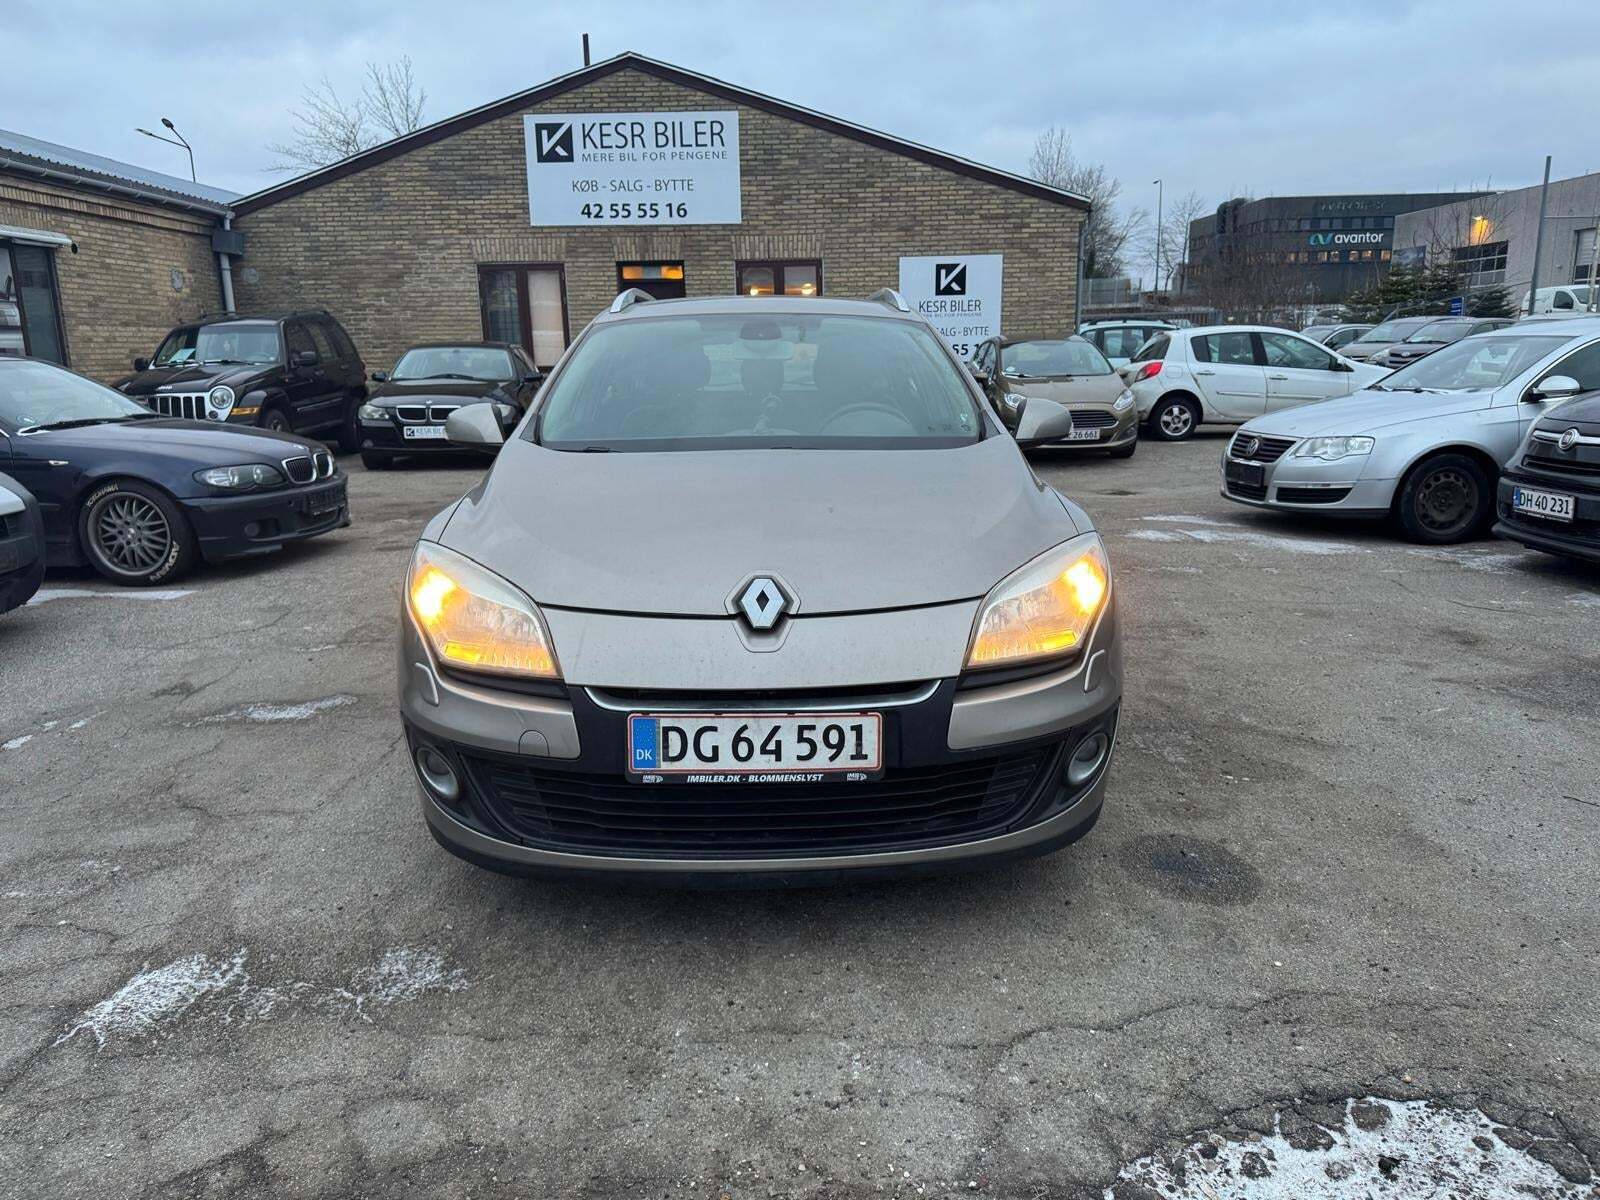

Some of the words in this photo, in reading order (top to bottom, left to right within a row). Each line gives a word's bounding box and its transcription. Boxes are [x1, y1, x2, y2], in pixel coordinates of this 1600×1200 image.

[581, 121, 646, 149] KESR
[654, 120, 726, 148] BILER
[581, 152, 614, 162] MERE
[619, 152, 636, 162] BIL
[642, 152, 666, 161] FOR
[671, 151, 728, 161] PENGENE
[572, 180, 599, 193] KØB
[610, 179, 643, 192] SALG
[654, 178, 694, 192] BYTTE
[580, 203, 603, 219] 42
[609, 203, 632, 218] 55
[637, 203, 659, 218] 55
[665, 202, 688, 218] 16
[1334, 231, 1384, 244] avantor
[919, 300, 947, 312] KESR
[950, 299, 982, 312] BILER
[936, 327, 957, 337] ALG
[963, 326, 989, 337] BYTTE
[1084, 430, 1098, 438] 661
[1520, 492, 1533, 508] DH
[1535, 495, 1548, 511] 40
[1550, 497, 1570, 515] 231
[661, 725, 719, 763] DG
[731, 724, 782, 763] 64
[796, 723, 869, 763] 591
[636, 749, 653, 761] DK
[687, 775, 740, 783] IMBILER.DK
[748, 774, 824, 782] BLOMMENSLYST
